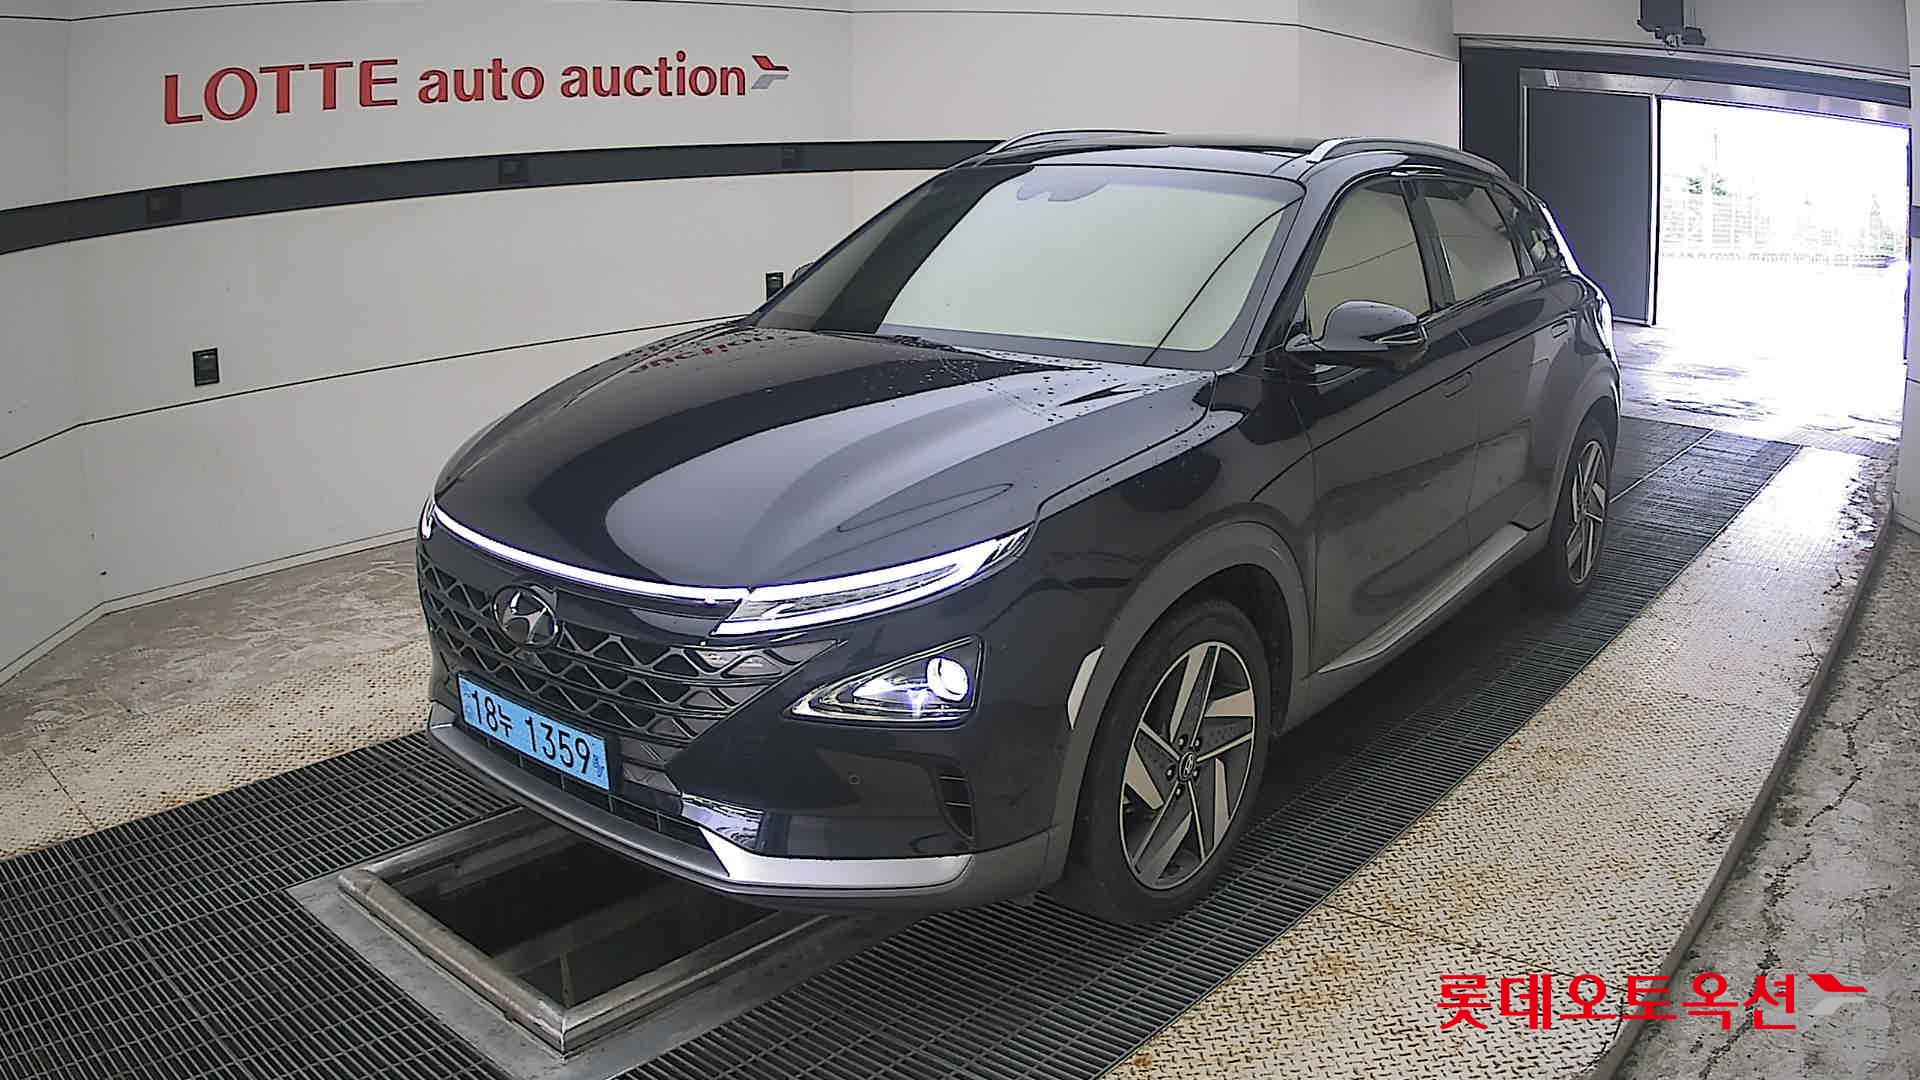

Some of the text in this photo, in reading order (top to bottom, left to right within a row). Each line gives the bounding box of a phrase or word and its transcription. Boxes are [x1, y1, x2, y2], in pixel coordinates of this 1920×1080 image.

[163, 50, 747, 125] LOTTE auto auction
[471, 689, 514, 738] 18누
[524, 715, 592, 775] 1359
